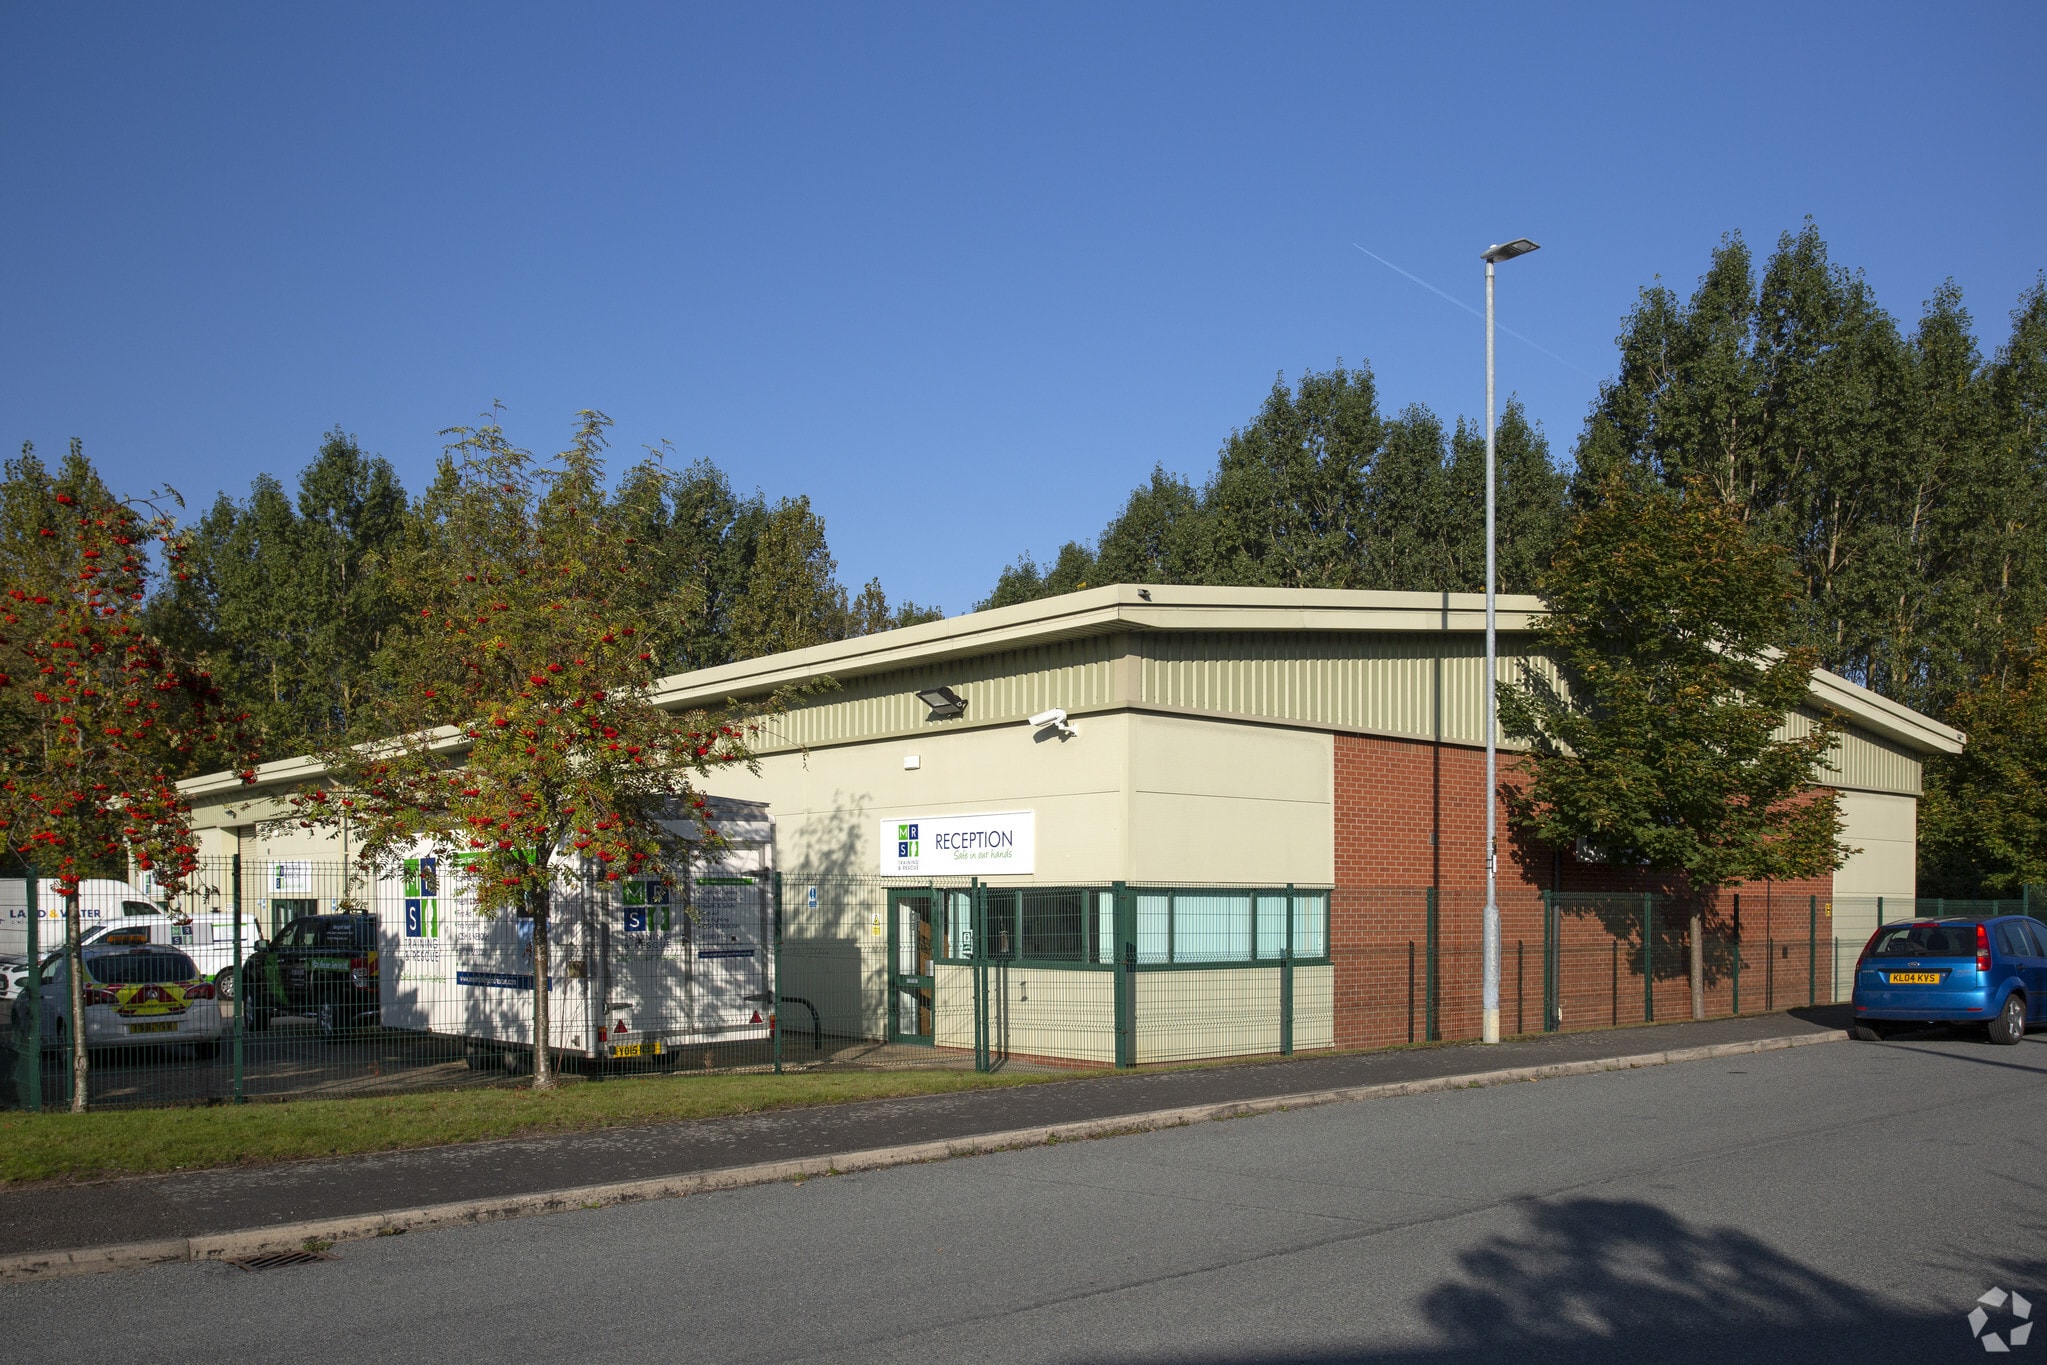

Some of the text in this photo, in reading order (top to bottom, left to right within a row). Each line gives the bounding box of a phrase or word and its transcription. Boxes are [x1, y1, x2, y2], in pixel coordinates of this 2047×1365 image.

[935, 830, 1013, 850] RECEPTION
[953, 848, 1012, 860] Safe in our hands
[10, 908, 101, 918] LAD & TER
[404, 939, 438, 949] TRAINING
[412, 951, 439, 962] RESCUE
[1893, 974, 1935, 982] KL04 KVS
